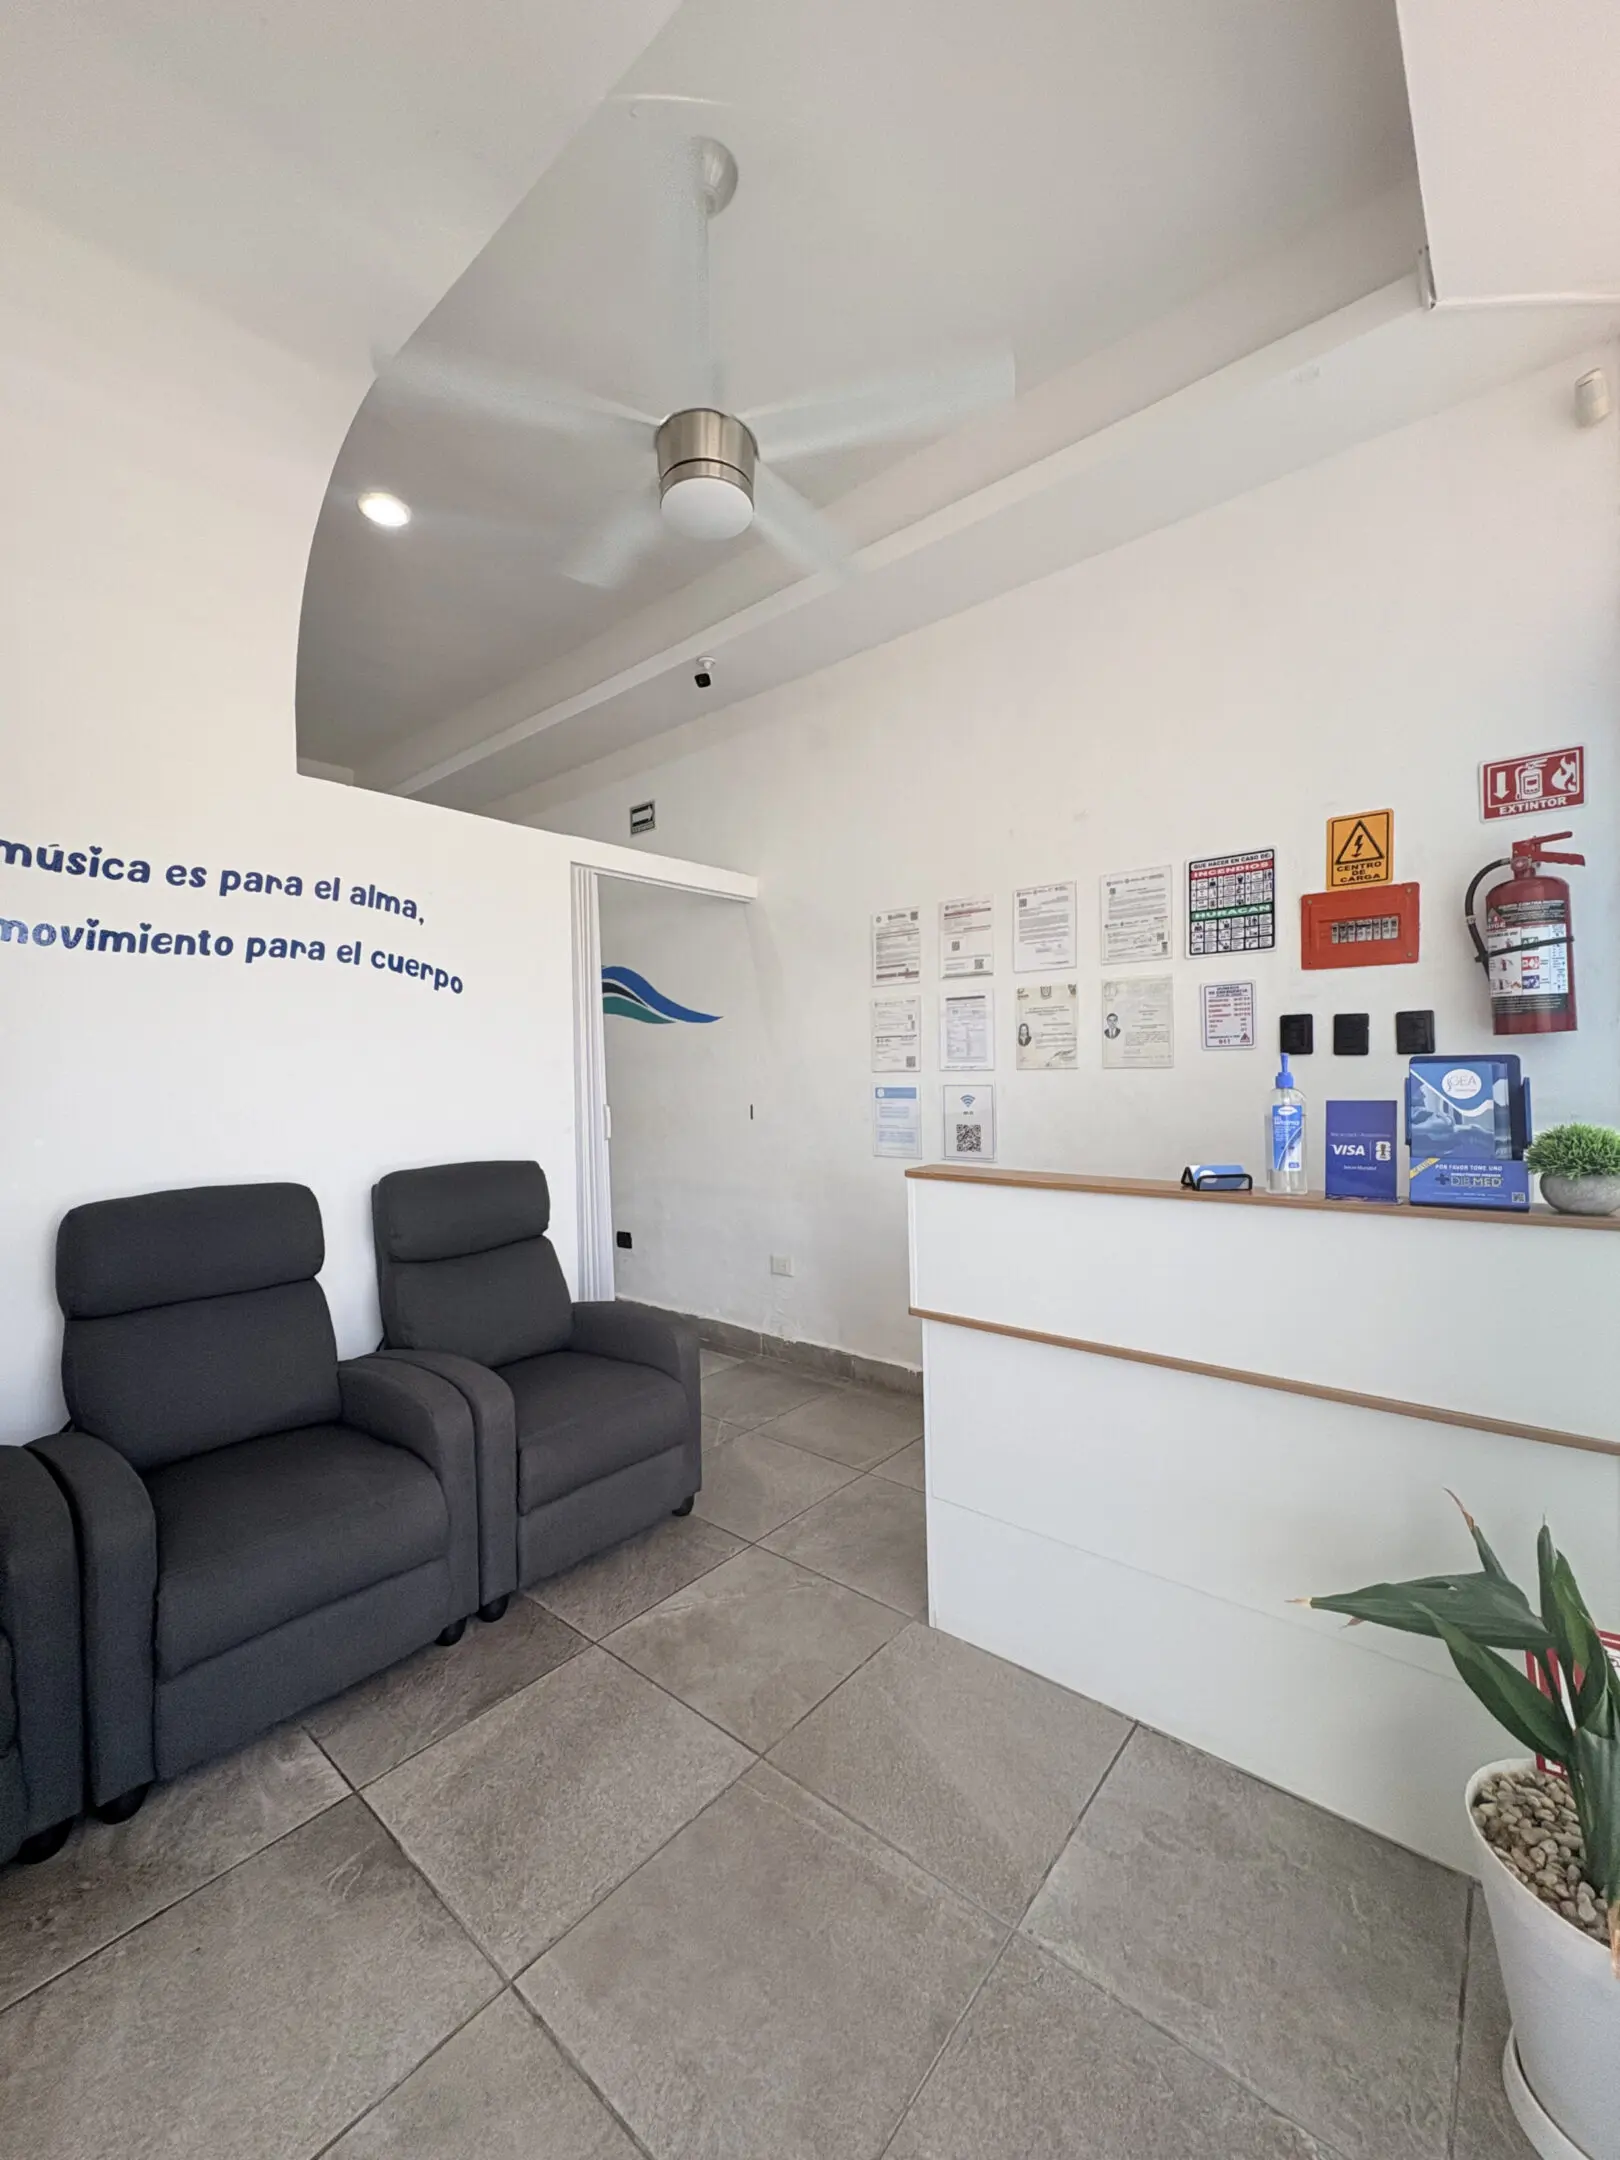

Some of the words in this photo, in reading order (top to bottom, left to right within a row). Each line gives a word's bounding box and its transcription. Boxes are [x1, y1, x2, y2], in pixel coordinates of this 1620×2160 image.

[1499, 796, 1568, 815] EXTINTOR
[1194, 861, 1270, 878] INCENDIOS
[1336, 861, 1382, 872] CENTRO
[0, 838, 151, 883] música
[165, 864, 208, 888] es
[219, 869, 303, 897] para
[314, 877, 341, 902] el
[349, 884, 425, 926] alma,
[1340, 873, 1381, 883] CARGA
[1194, 904, 1271, 919] HURACAN
[0, 917, 234, 957] movimiento
[245, 936, 326, 964] para
[336, 940, 362, 966] el
[370, 950, 464, 995] cuerpo
[1330, 1143, 1366, 1156] VISA
